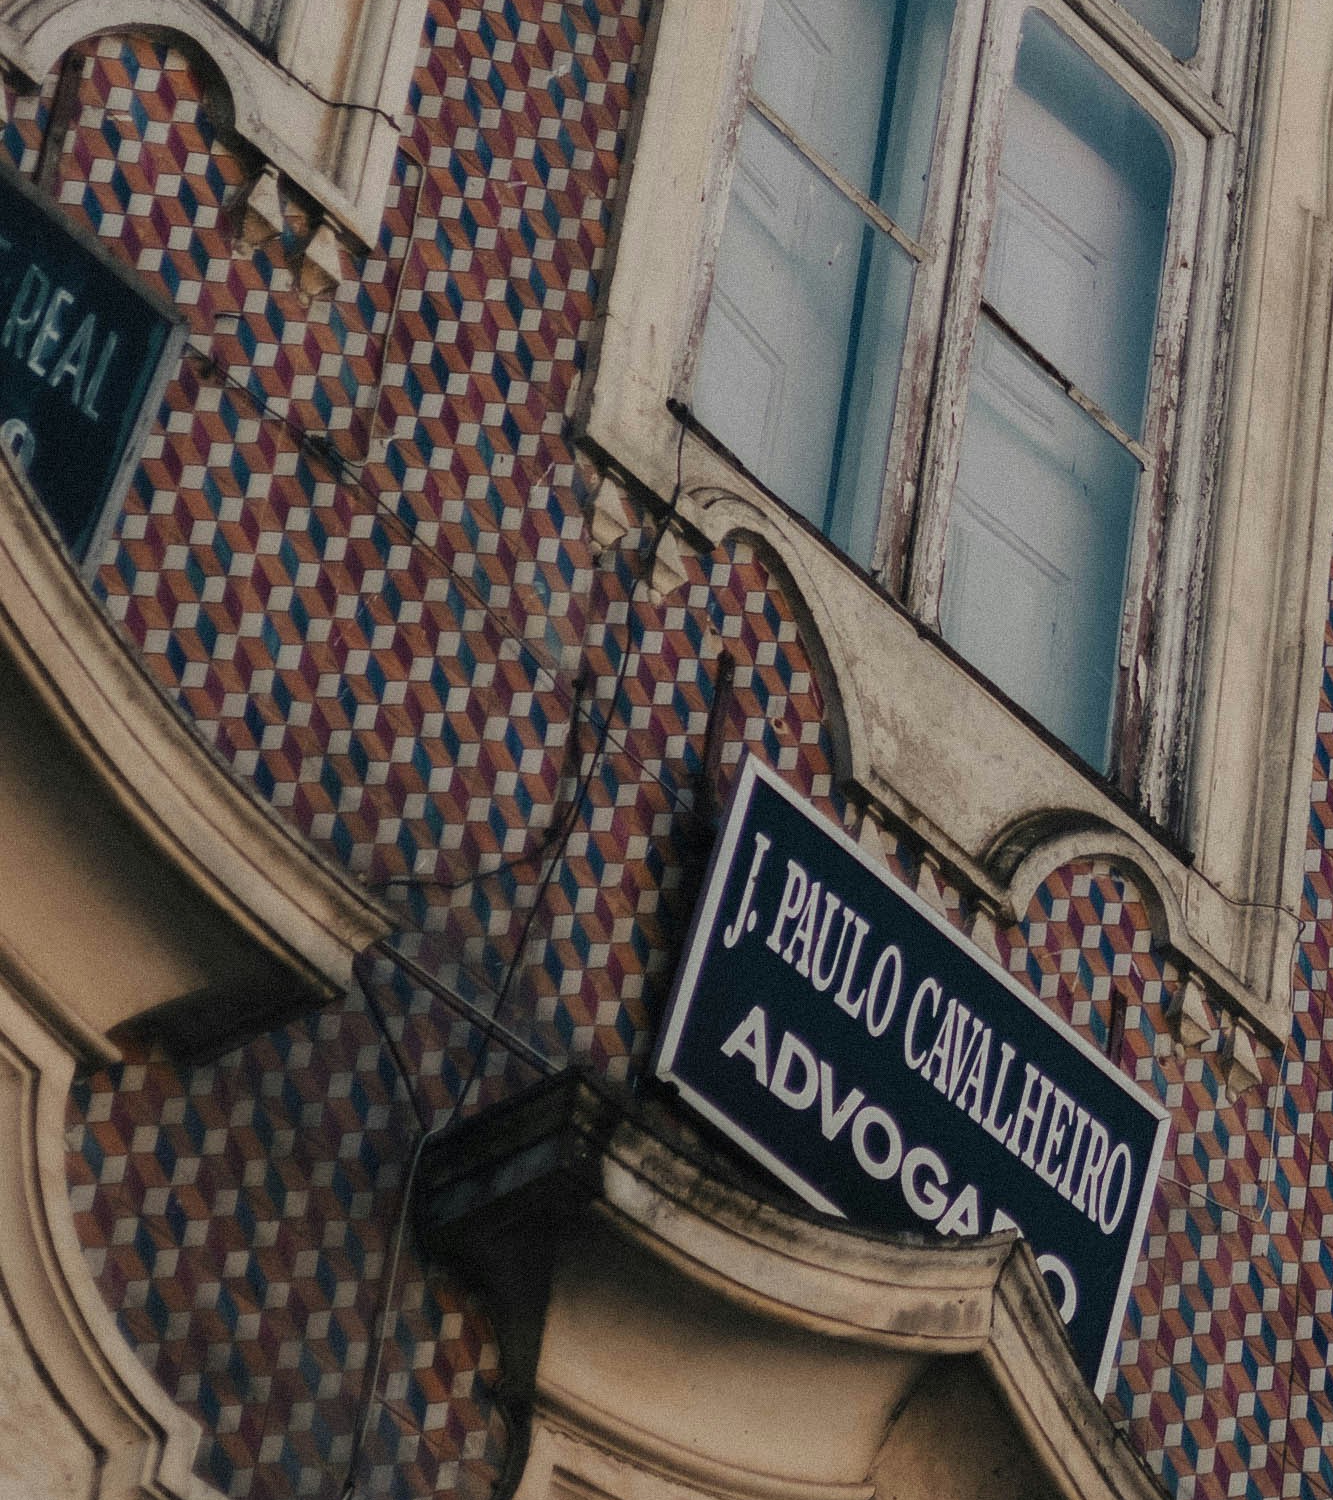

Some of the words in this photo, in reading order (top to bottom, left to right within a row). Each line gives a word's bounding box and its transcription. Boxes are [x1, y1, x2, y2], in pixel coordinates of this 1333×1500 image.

[720, 1005, 1076, 1325] ADVOGAO
[723, 832, 771, 949] J.
[766, 859, 902, 1038] PAULO
[904, 977, 1133, 1235] CAVALHEIRO
